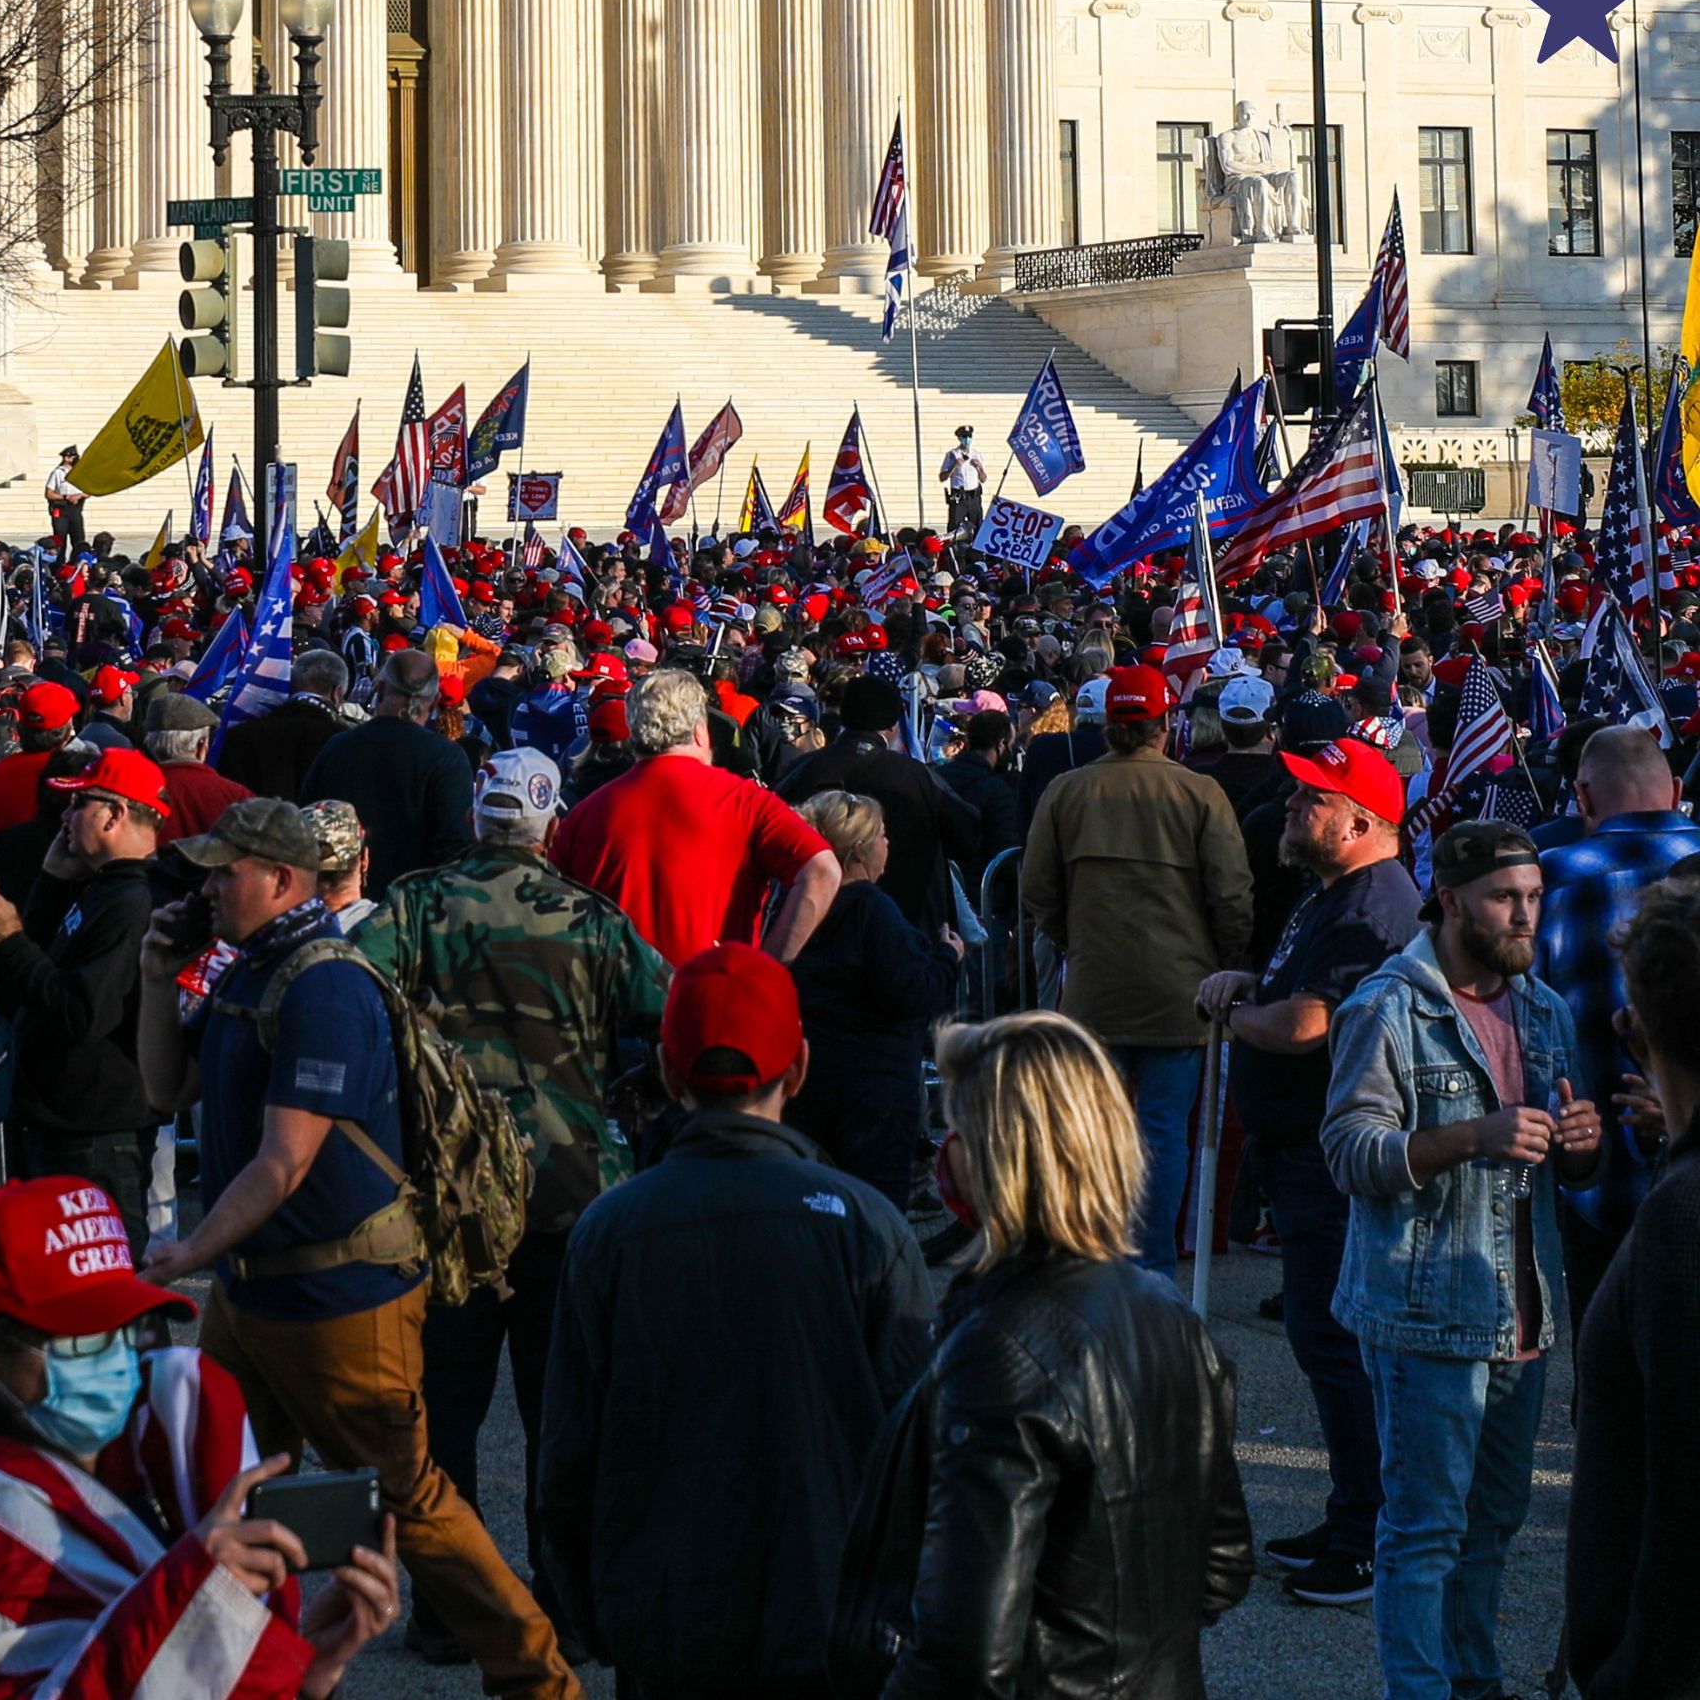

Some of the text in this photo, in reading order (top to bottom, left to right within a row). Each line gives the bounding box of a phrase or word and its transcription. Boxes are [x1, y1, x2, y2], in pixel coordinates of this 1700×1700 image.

[286, 171, 378, 193] FIRST ST
[362, 182, 379, 192] NE
[310, 196, 352, 211] UNIT
[170, 201, 236, 223] MARYLAND
[1012, 533, 1034, 547] the
[845, 636, 864, 645] USA
